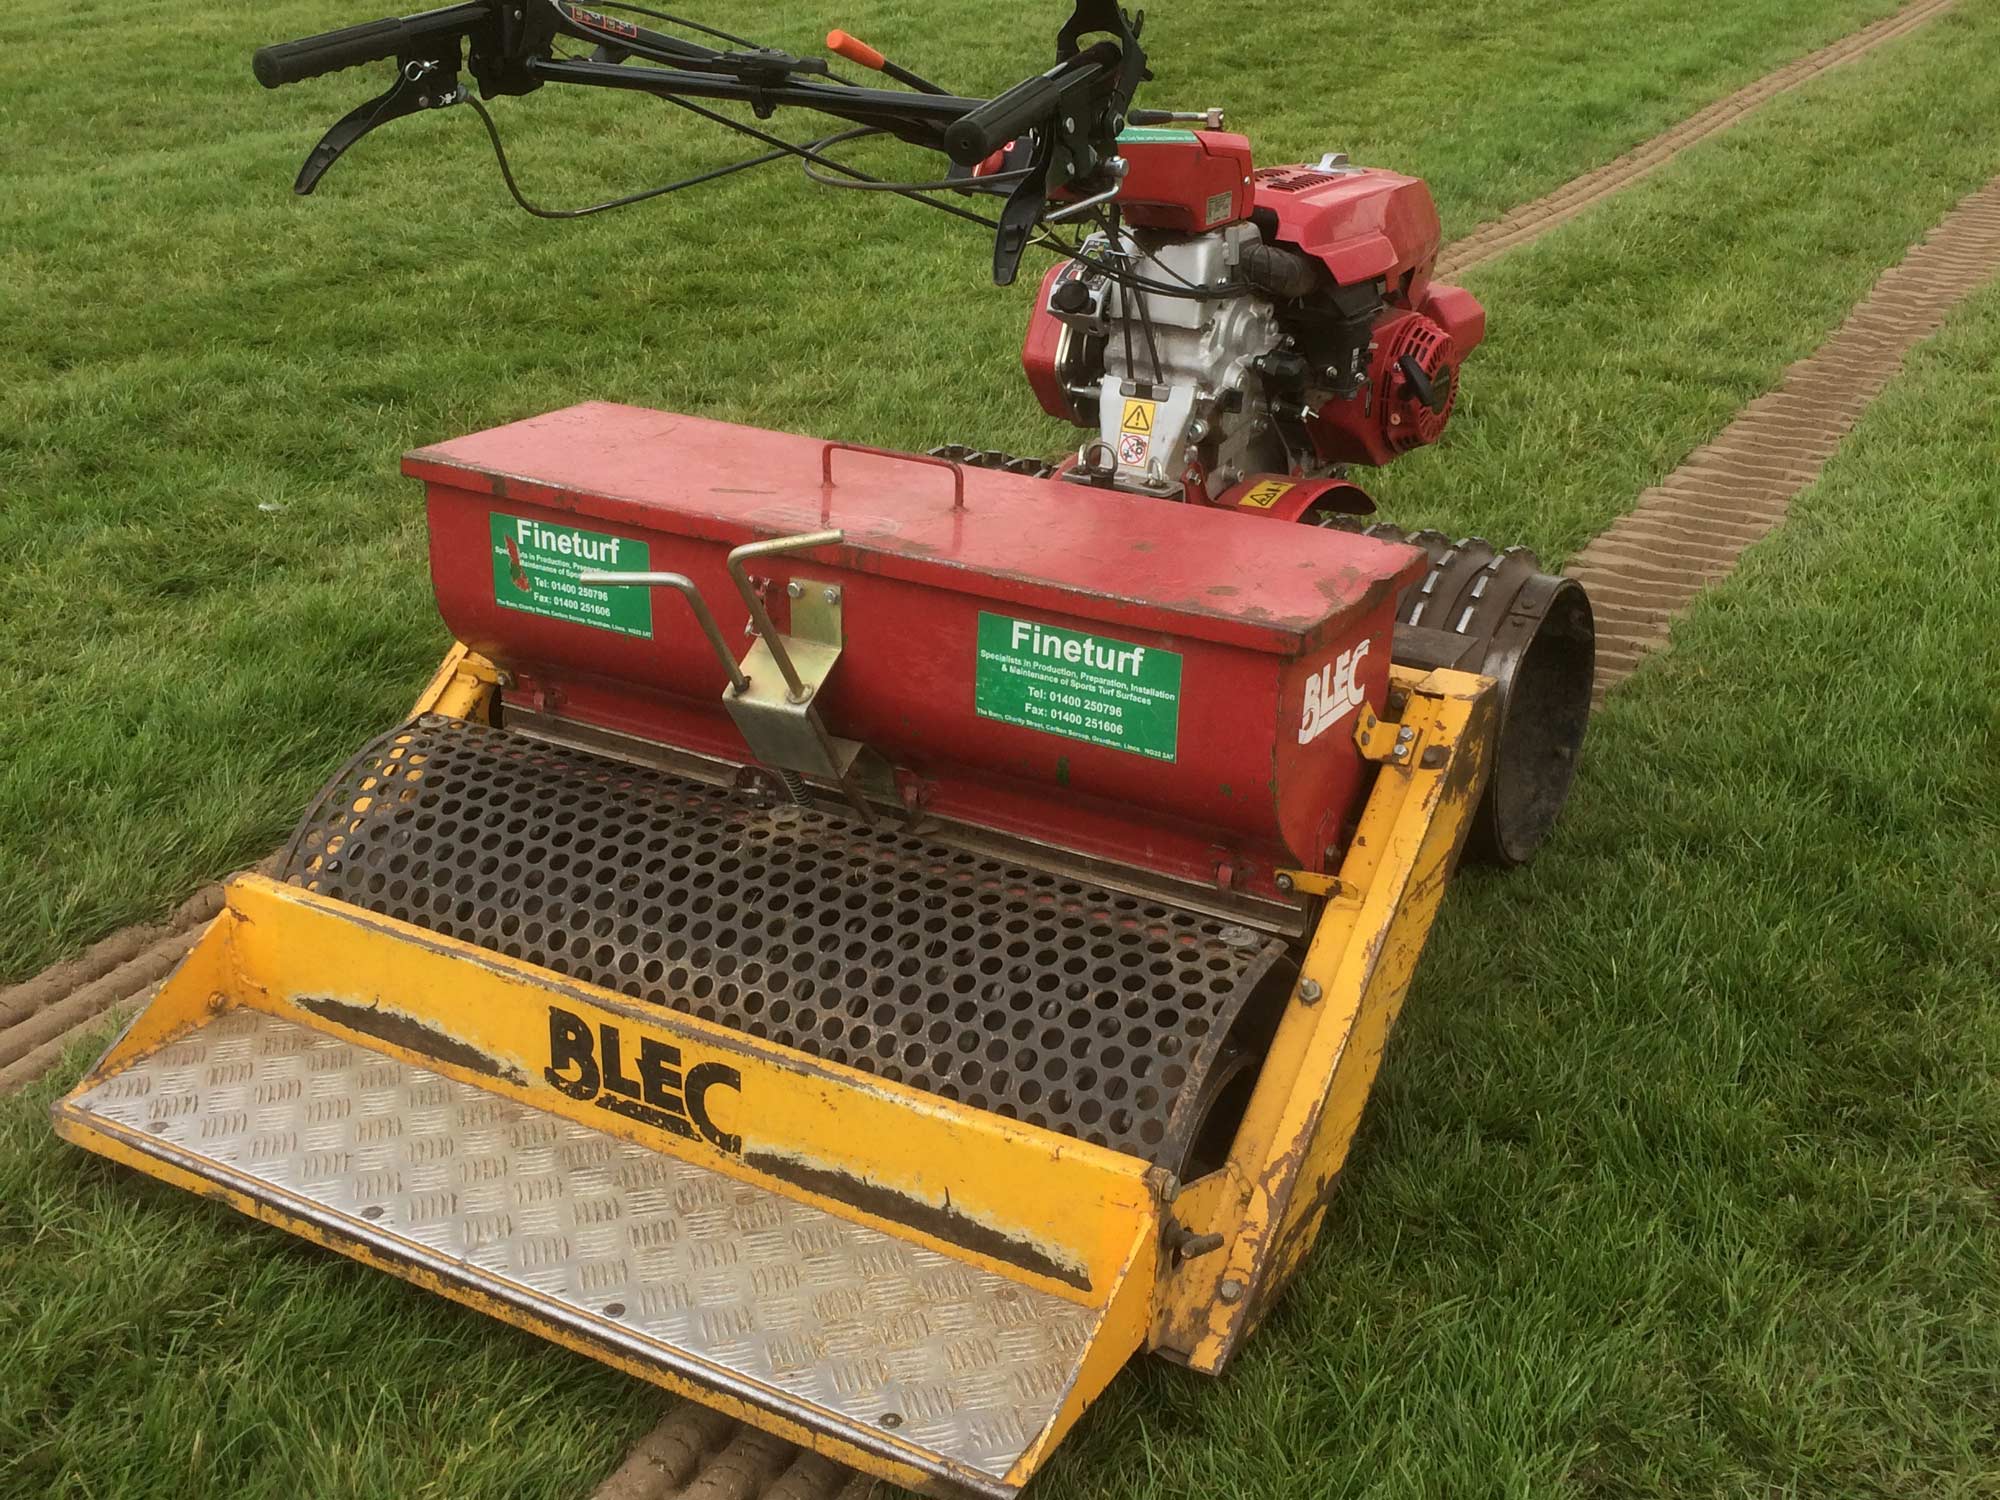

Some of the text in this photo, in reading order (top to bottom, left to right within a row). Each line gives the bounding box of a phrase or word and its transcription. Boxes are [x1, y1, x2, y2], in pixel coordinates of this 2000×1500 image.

[517, 519, 620, 564] Fineturf
[533, 592, 611, 617] Fax: 01400 251606
[534, 576, 608, 602] Tel: 01400 250796
[1011, 620, 1145, 677] Fineturf
[980, 649, 1022, 665] Specialists
[1033, 661, 1078, 679] Production,
[1080, 671, 1129, 691] Preparation,
[1130, 683, 1175, 701] Installation
[1001, 664, 1151, 705] & Maintenance of Sports Turf Surfaces
[1298, 639, 1370, 745] BLEC
[1024, 702, 1123, 735] Fax: 01400 251606
[1027, 686, 1122, 717] Tel: 01400 250796
[544, 1005, 742, 1155] BLEC
